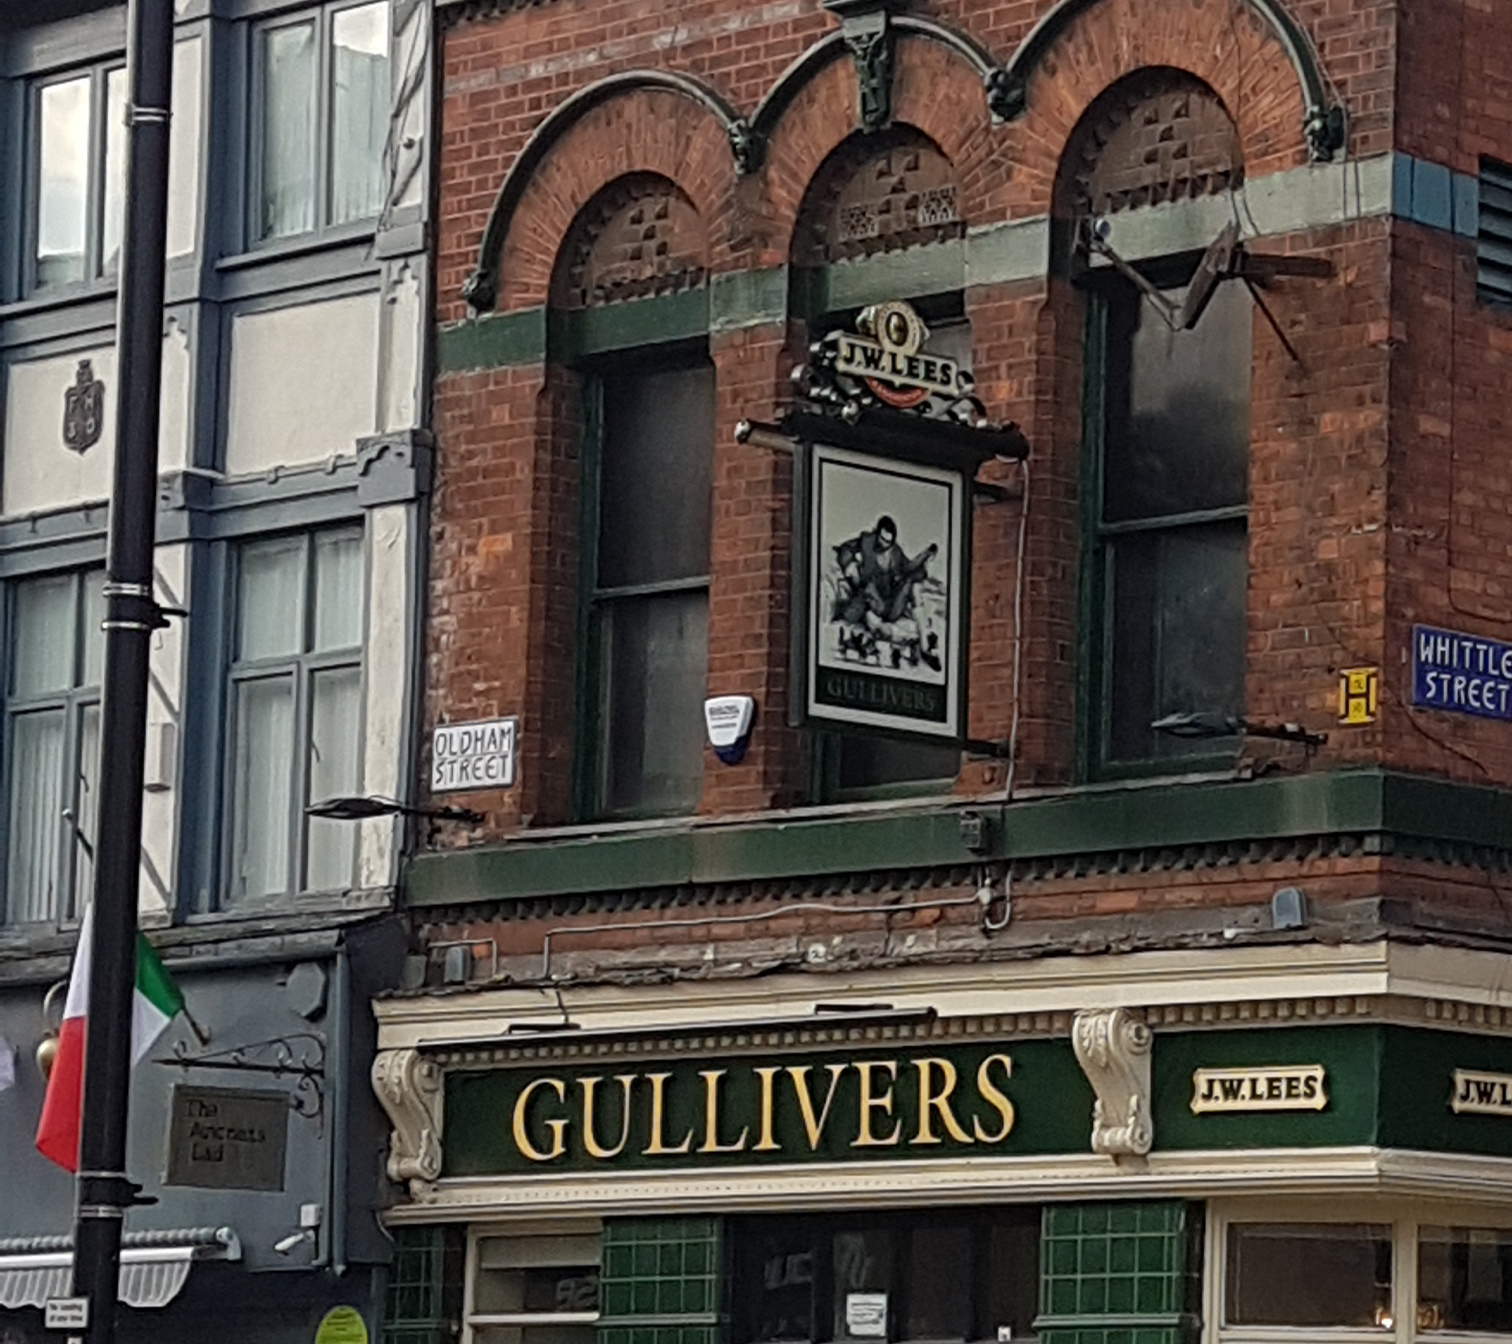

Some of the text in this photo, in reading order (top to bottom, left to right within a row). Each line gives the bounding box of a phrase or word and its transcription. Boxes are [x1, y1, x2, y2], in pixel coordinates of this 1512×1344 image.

[826, 676, 935, 712] GULLIVERS
[1338, 672, 1378, 720] H
[1425, 671, 1510, 712] STREET
[435, 726, 512, 757] OLDHAM
[435, 754, 509, 784] STREET
[511, 1053, 1017, 1162] GULLIVERS
